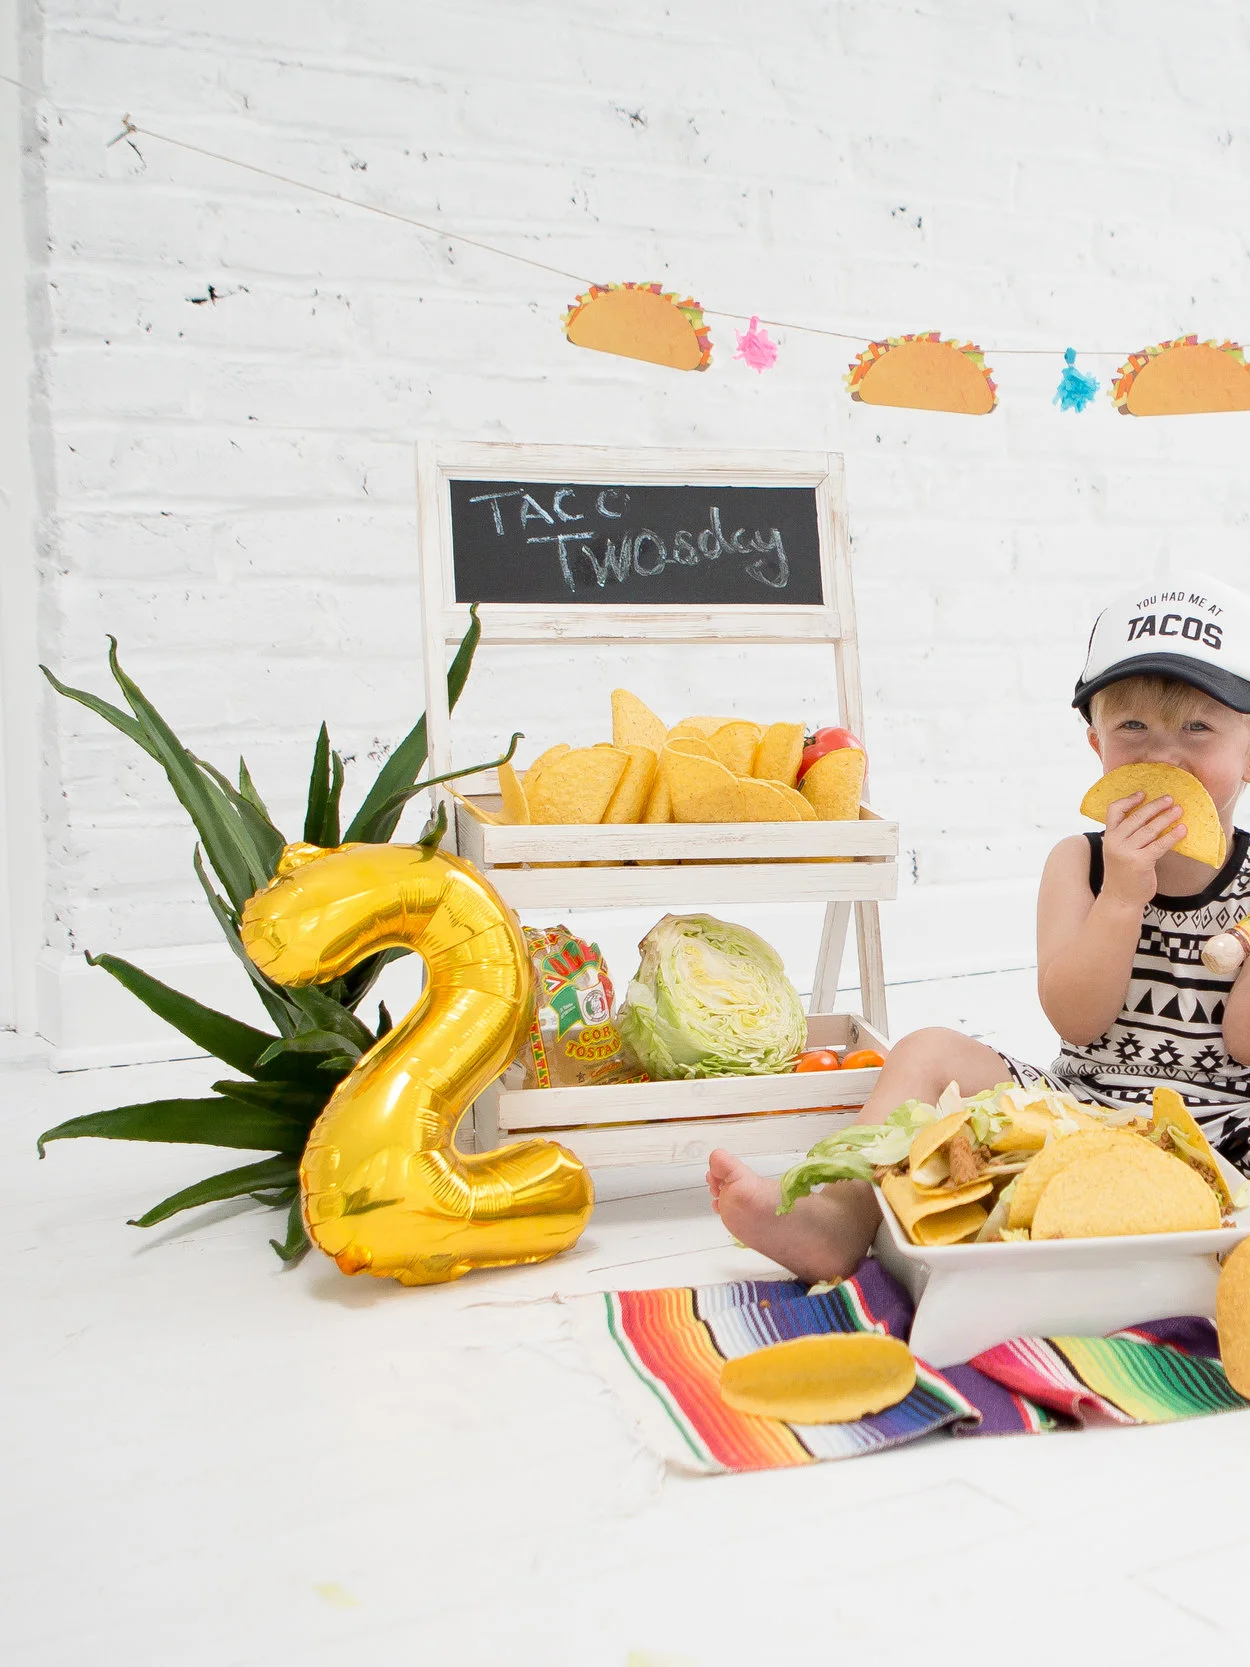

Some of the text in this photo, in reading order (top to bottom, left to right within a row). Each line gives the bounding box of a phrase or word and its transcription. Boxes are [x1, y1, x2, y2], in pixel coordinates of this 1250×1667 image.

[1136, 591, 1224, 617] YOU HAD ME AT
[1127, 613, 1224, 651] TACOS
[581, 1025, 615, 1042] COR
[240, 841, 595, 1286] 2
